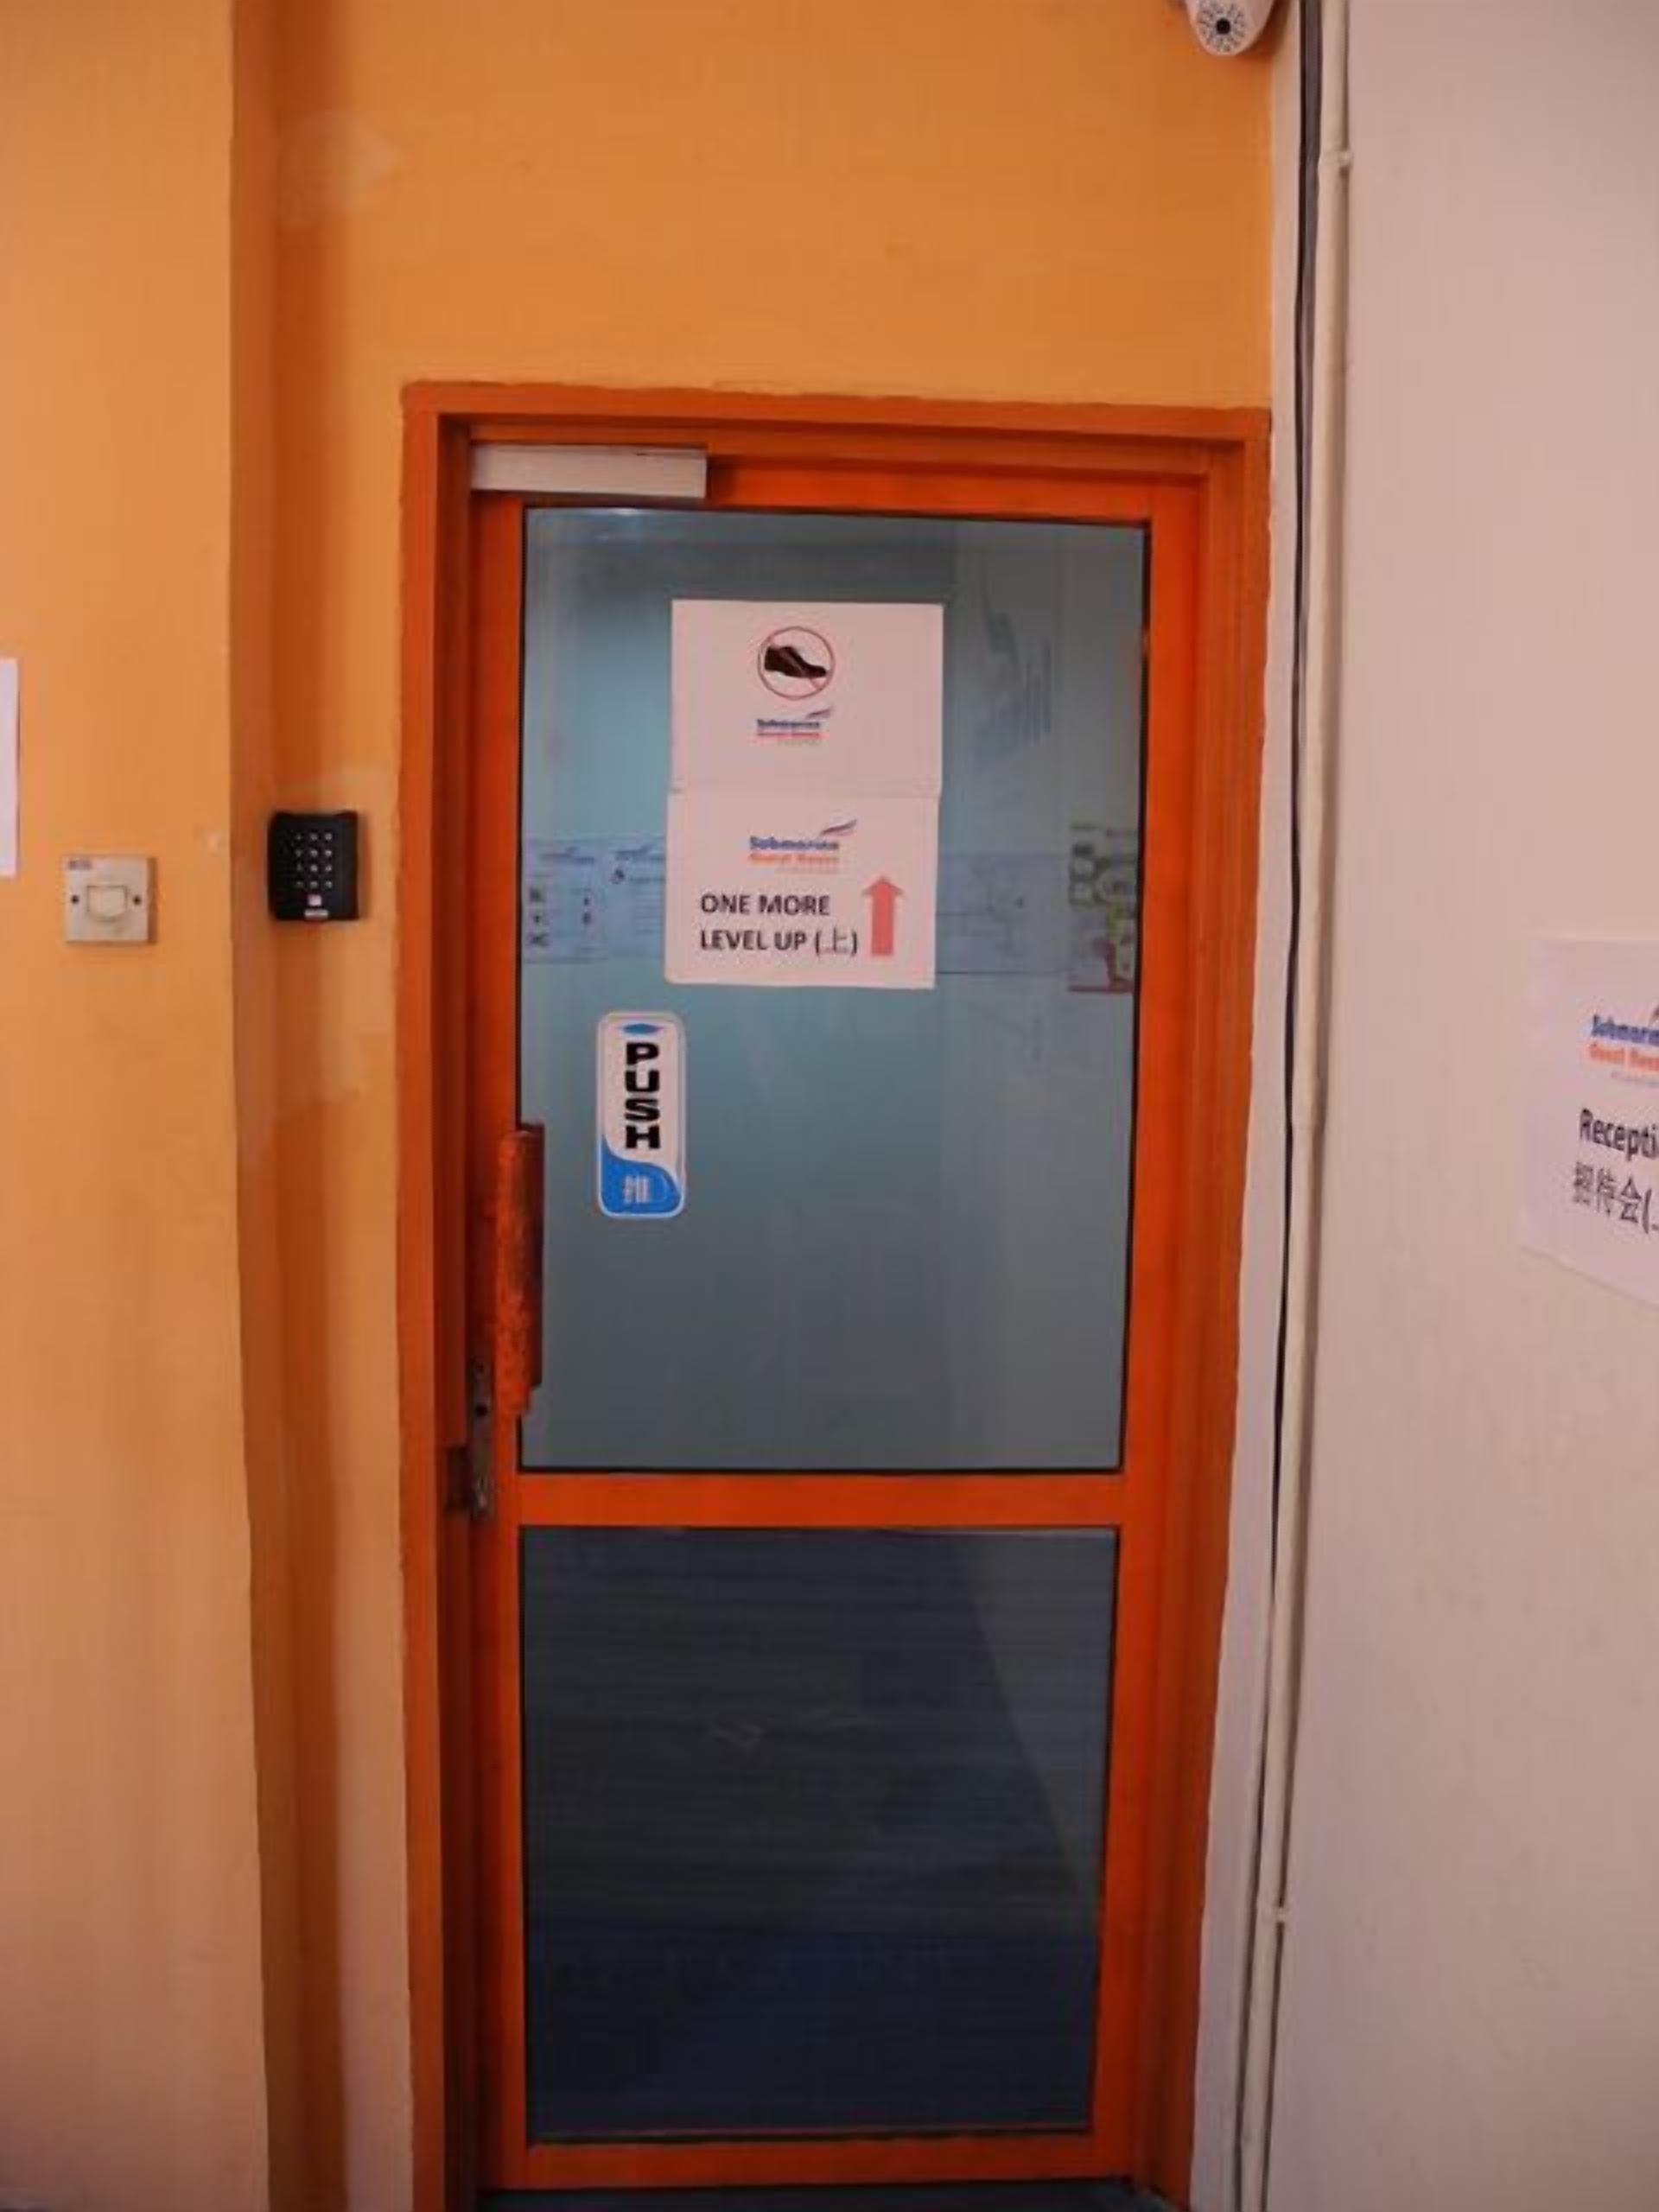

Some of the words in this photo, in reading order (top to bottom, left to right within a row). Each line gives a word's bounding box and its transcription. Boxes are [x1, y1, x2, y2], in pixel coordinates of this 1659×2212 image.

[701, 893, 751, 915] ONE
[759, 894, 830, 916] MORE
[701, 929, 768, 951] LEVEL
[774, 930, 807, 951] UP
[625, 1042, 661, 1149] PUSH
